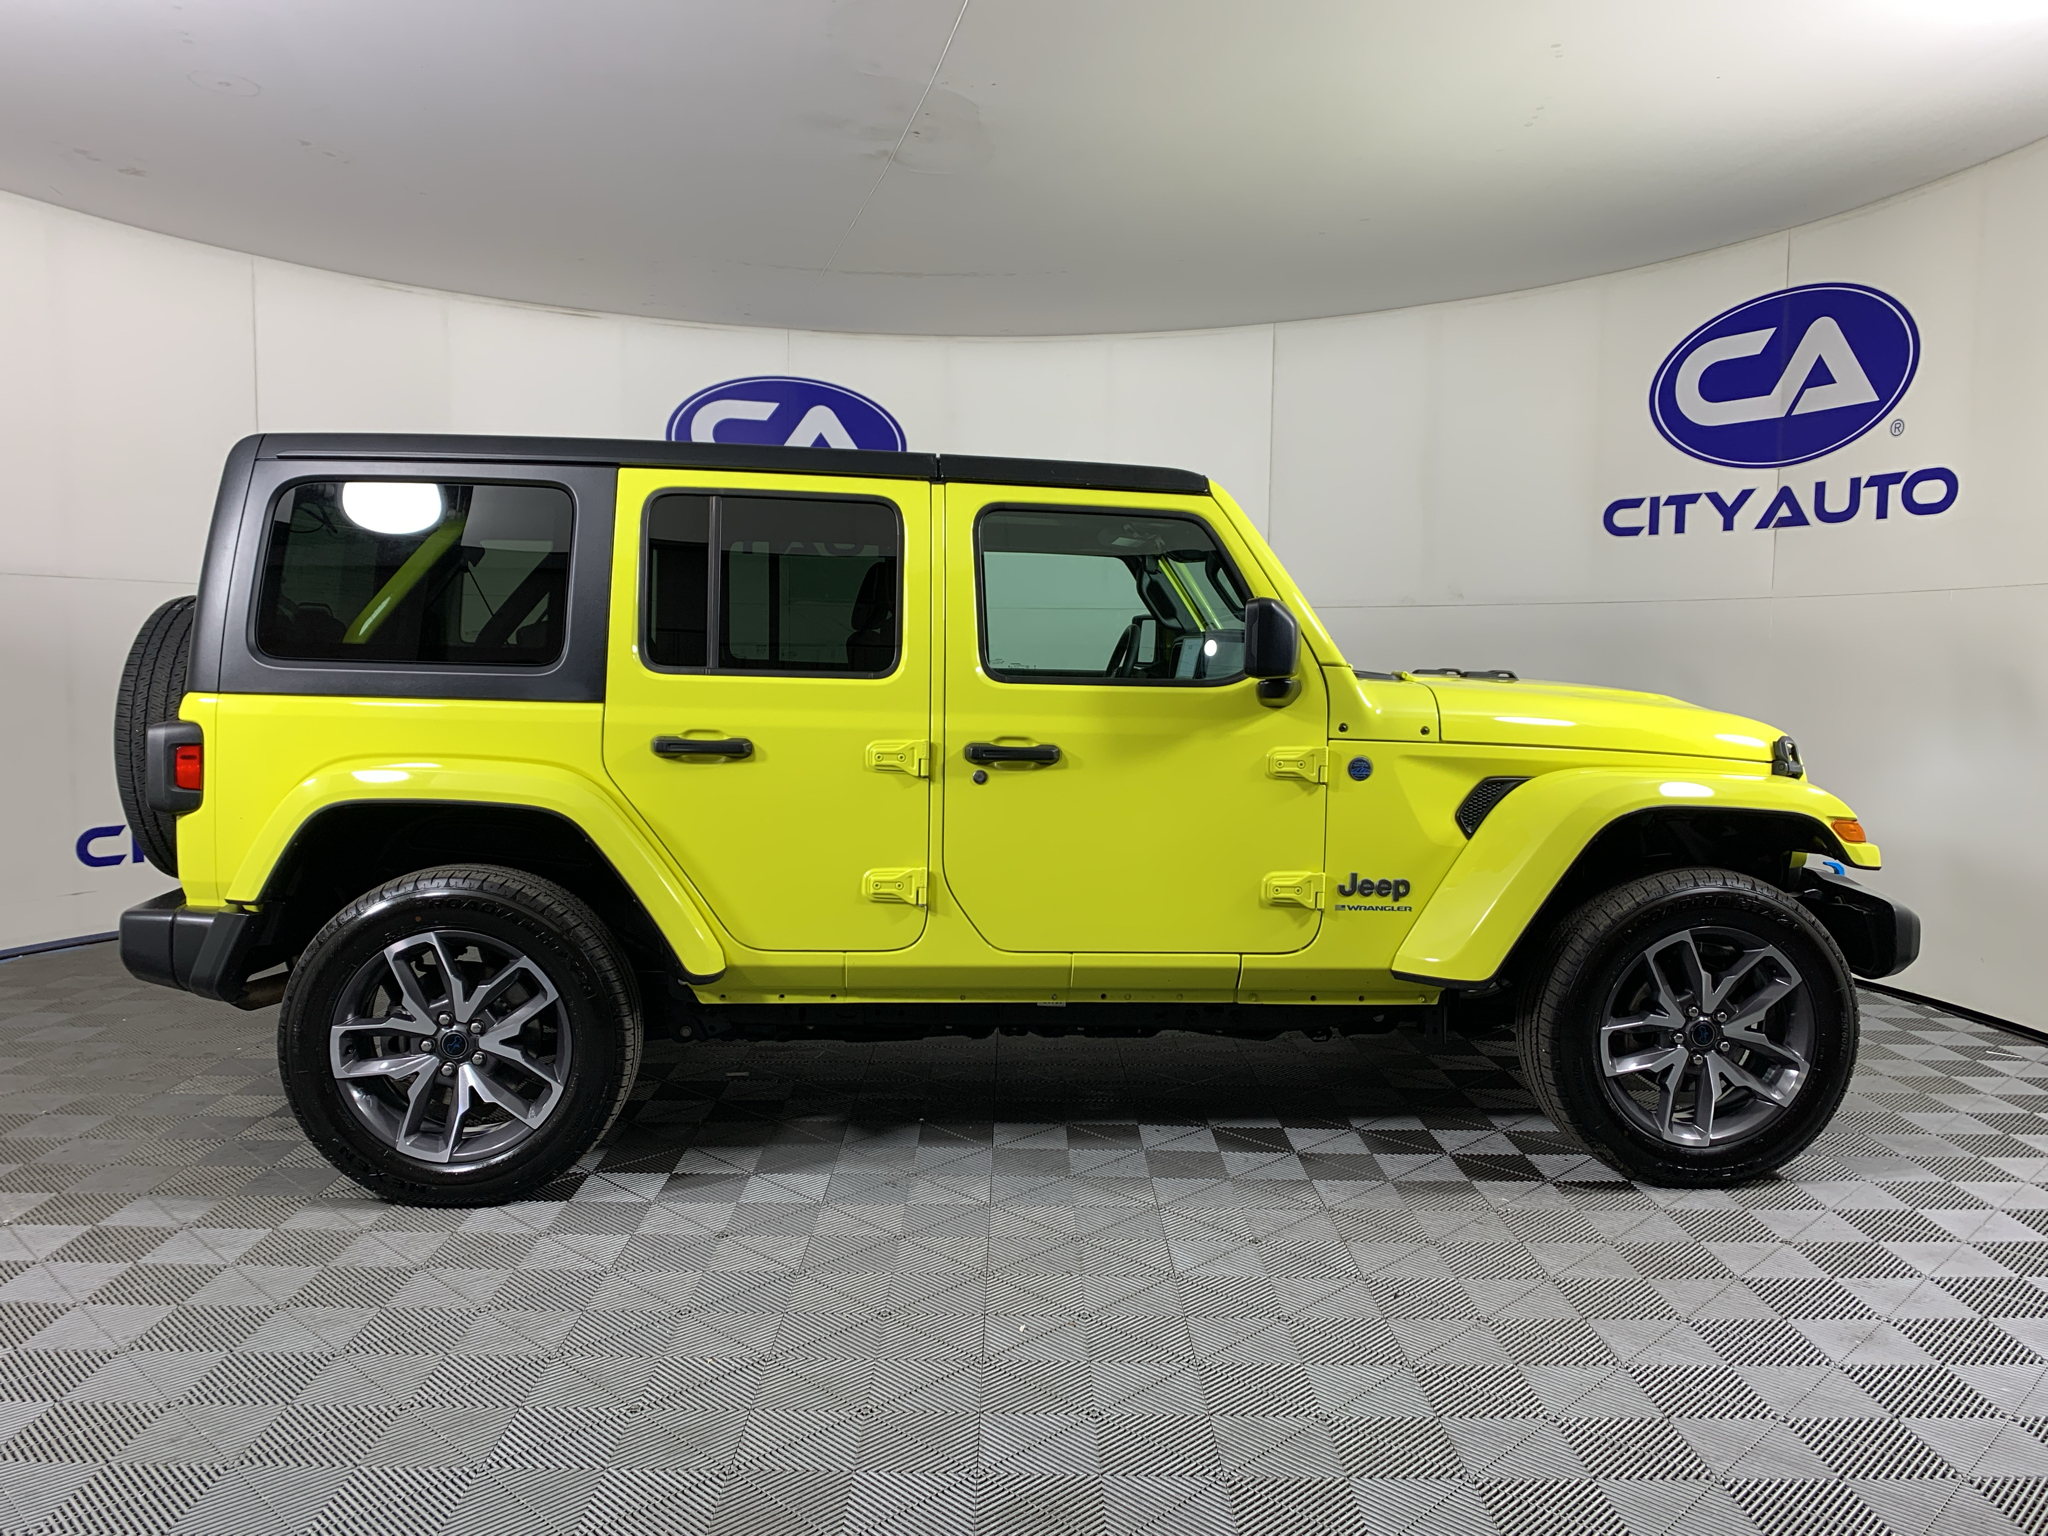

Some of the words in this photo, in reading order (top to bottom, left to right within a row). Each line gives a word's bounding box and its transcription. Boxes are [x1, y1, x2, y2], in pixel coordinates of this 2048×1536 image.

[1674, 315, 1880, 427] CA
[690, 399, 860, 450] CA
[1602, 487, 1758, 537] CITY
[1753, 466, 1960, 531] AUTO
[1337, 872, 1411, 902] Jeep
[1347, 904, 1413, 912] WRANGLER
